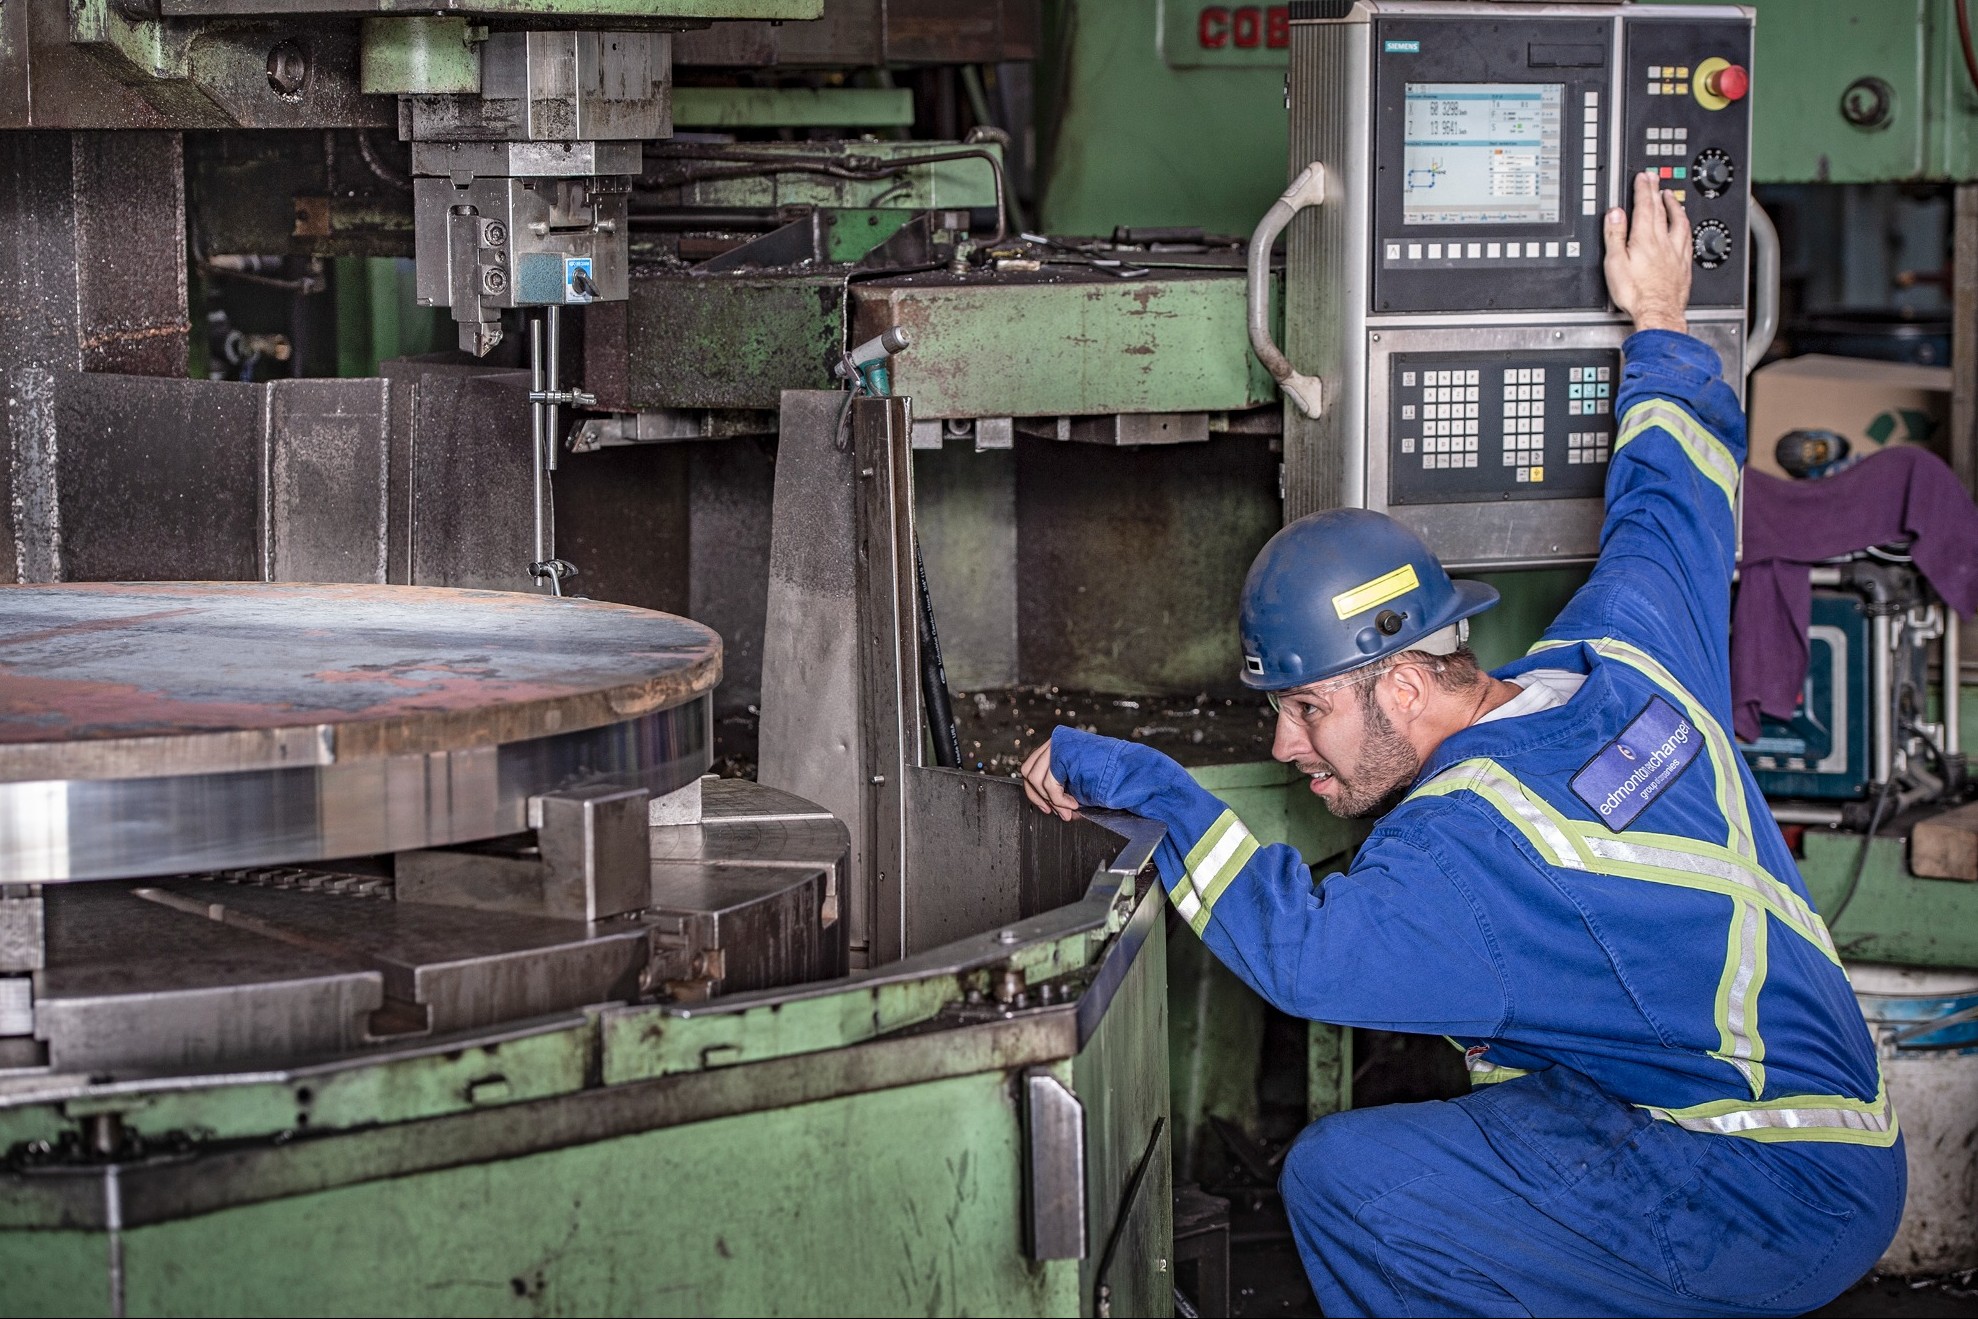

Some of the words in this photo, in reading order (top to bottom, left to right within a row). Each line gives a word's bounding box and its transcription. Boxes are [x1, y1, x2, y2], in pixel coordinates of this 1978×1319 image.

[1198, 5, 1289, 49] COB
[1387, 42, 1418, 50] SIEMENS
[1640, 781, 1658, 799] group
